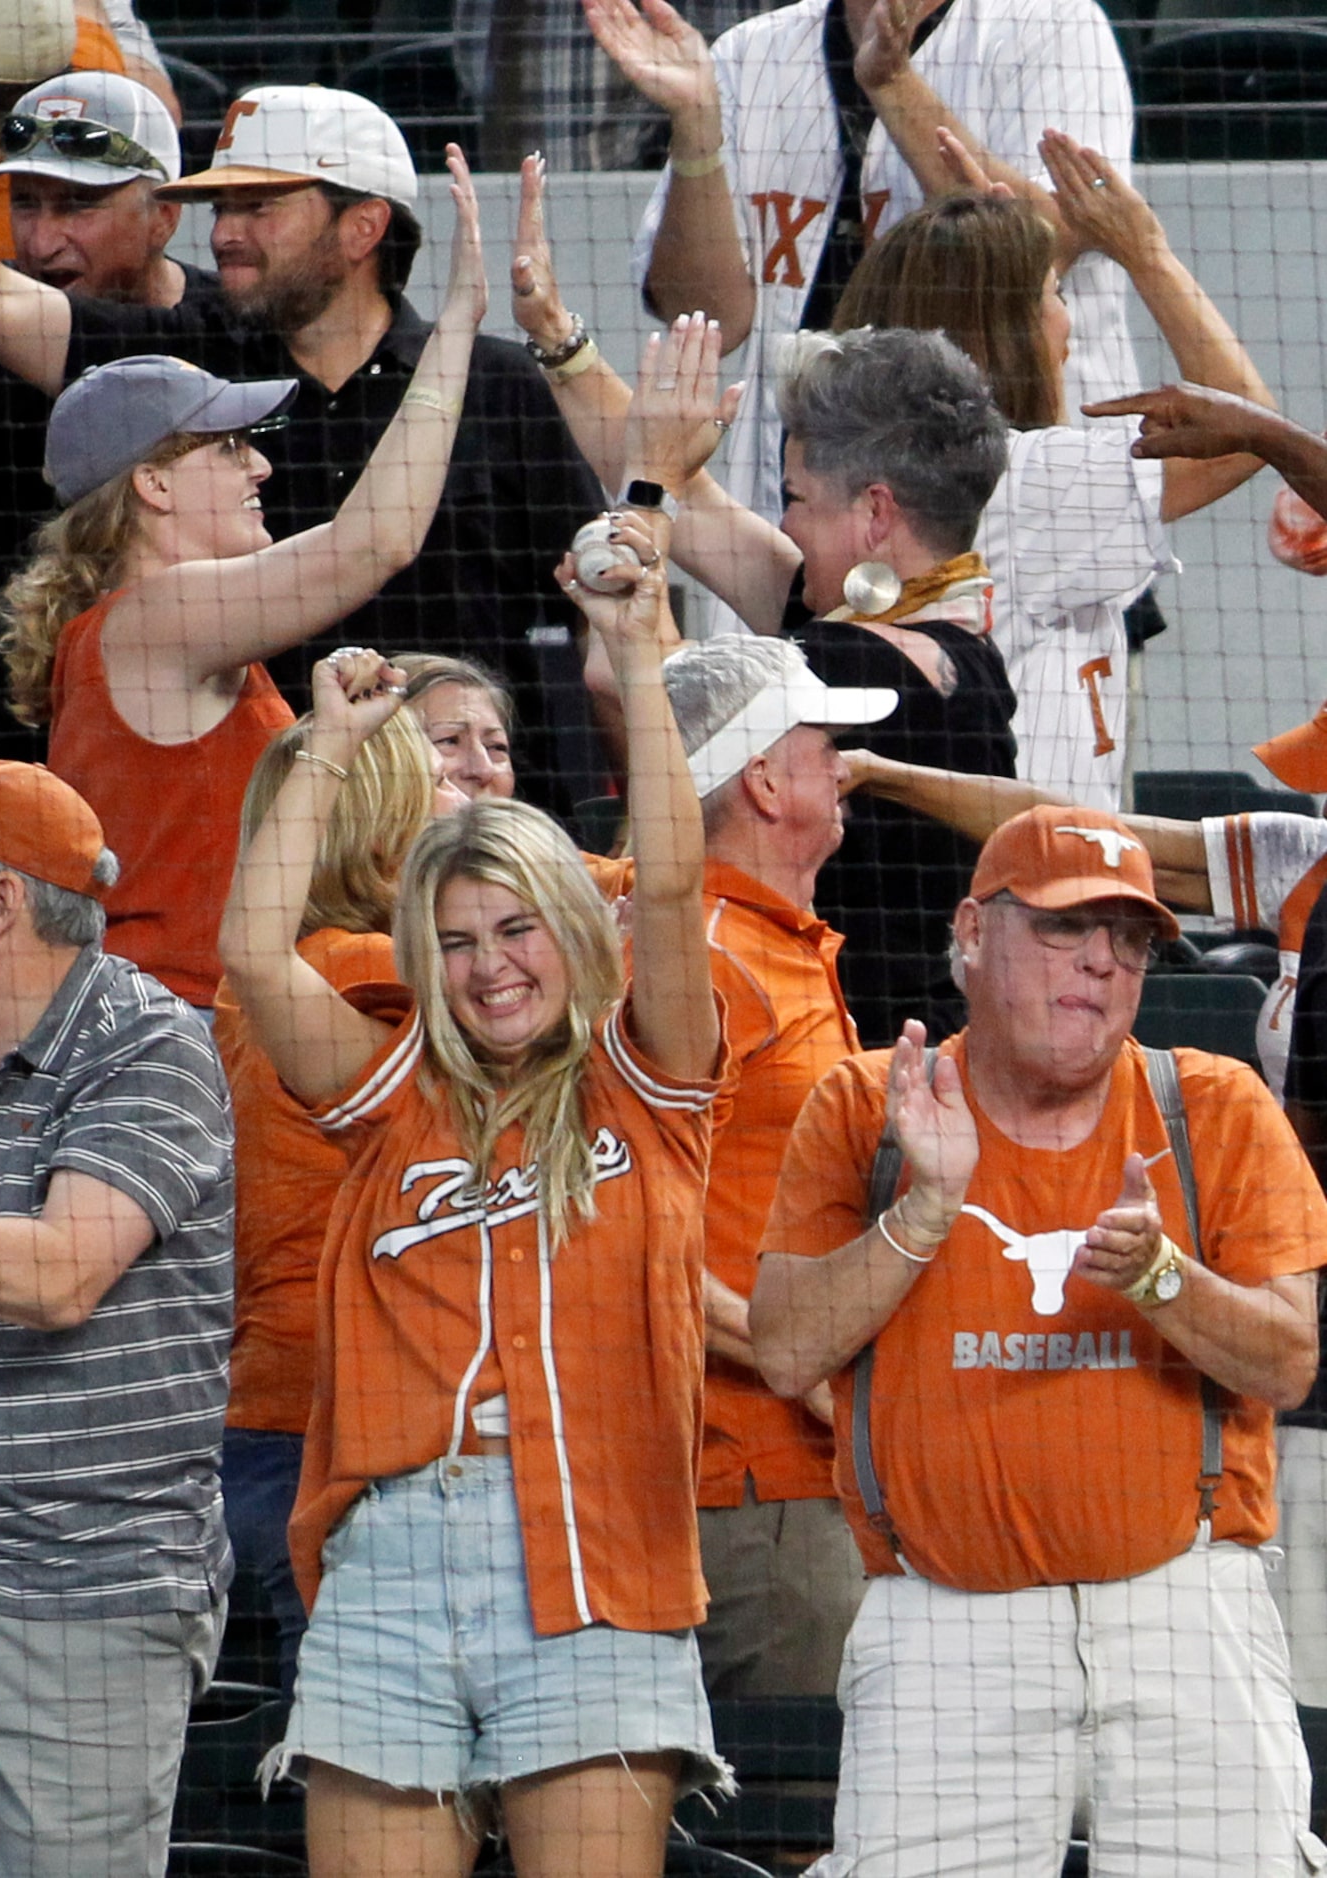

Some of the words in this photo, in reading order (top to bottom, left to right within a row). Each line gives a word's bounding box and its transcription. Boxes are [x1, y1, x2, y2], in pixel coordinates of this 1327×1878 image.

[1077, 655, 1114, 758] T
[383, 1127, 632, 1240] Texs
[953, 1330, 1137, 1371] BASEBALL
